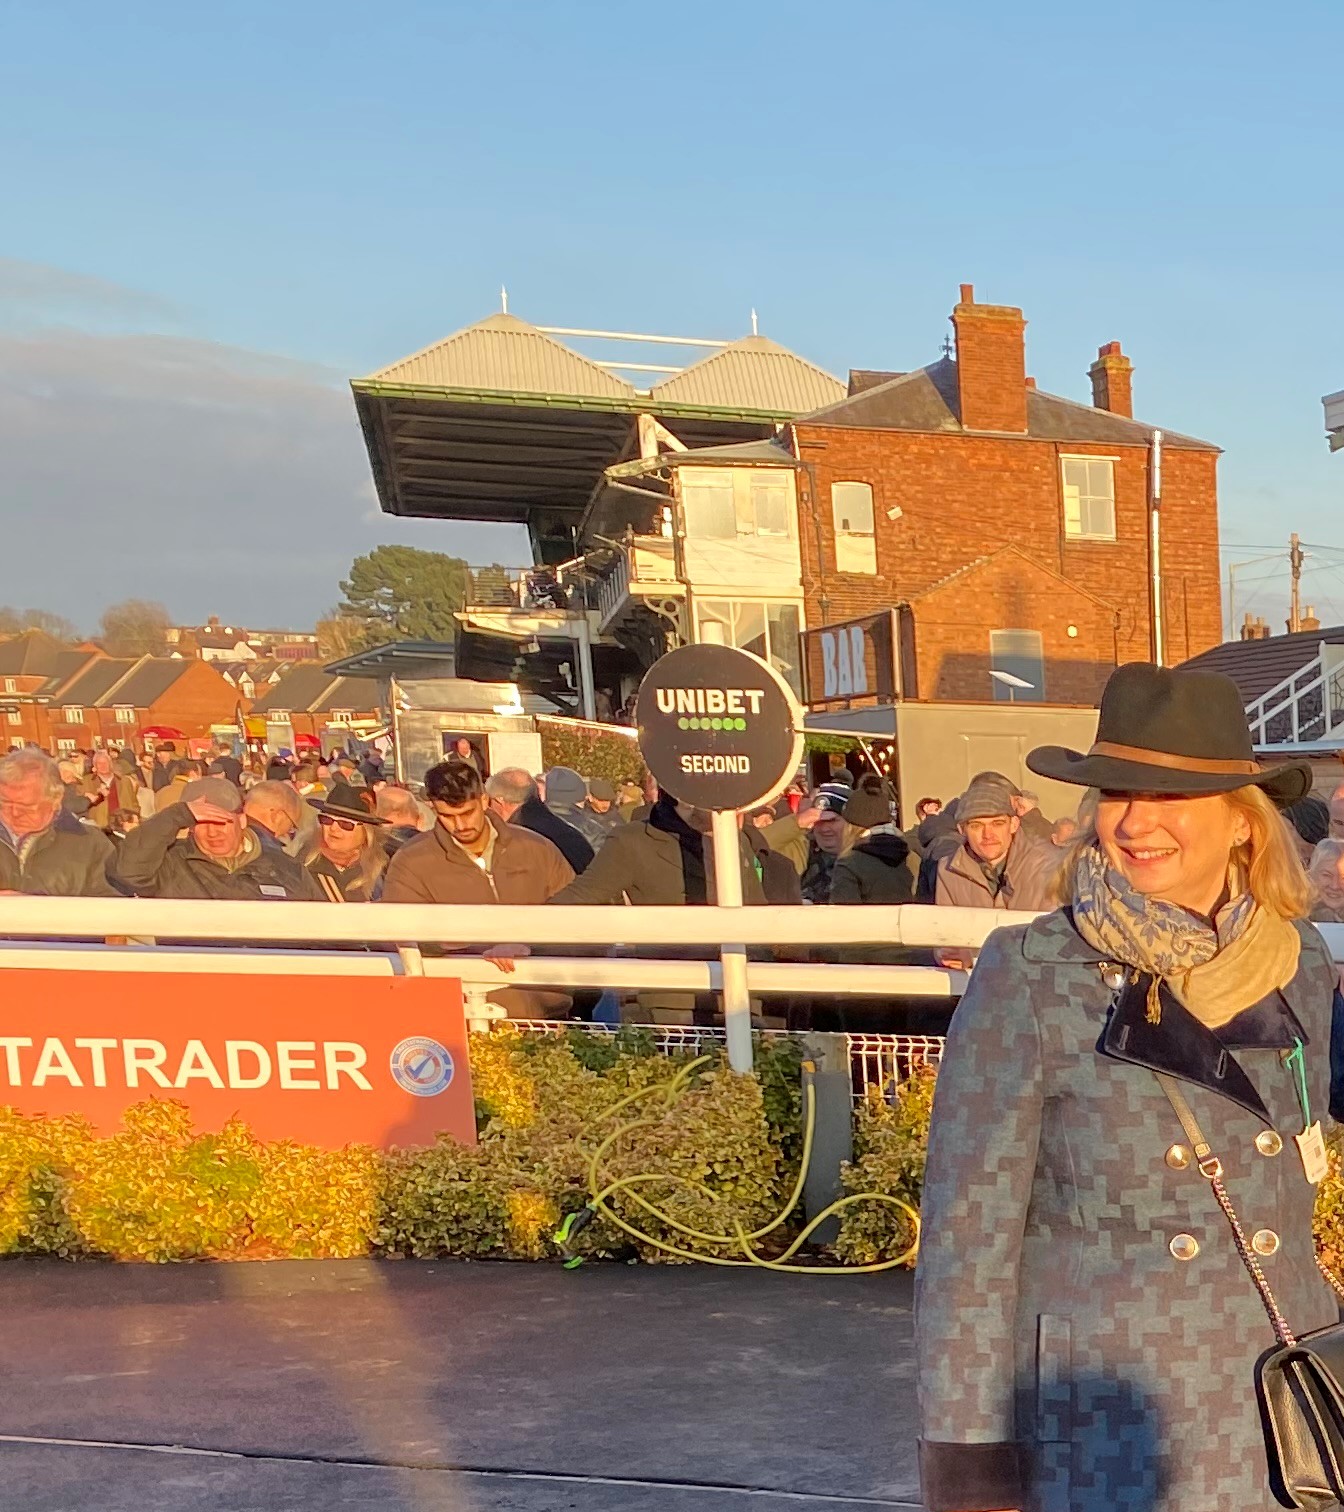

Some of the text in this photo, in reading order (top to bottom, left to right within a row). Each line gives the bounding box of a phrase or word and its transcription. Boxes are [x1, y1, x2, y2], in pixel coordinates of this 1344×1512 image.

[821, 625, 868, 698] BAR
[656, 688, 765, 715] UNIBET
[681, 754, 750, 774] SECOND
[0, 1036, 374, 1091] TATRADER
